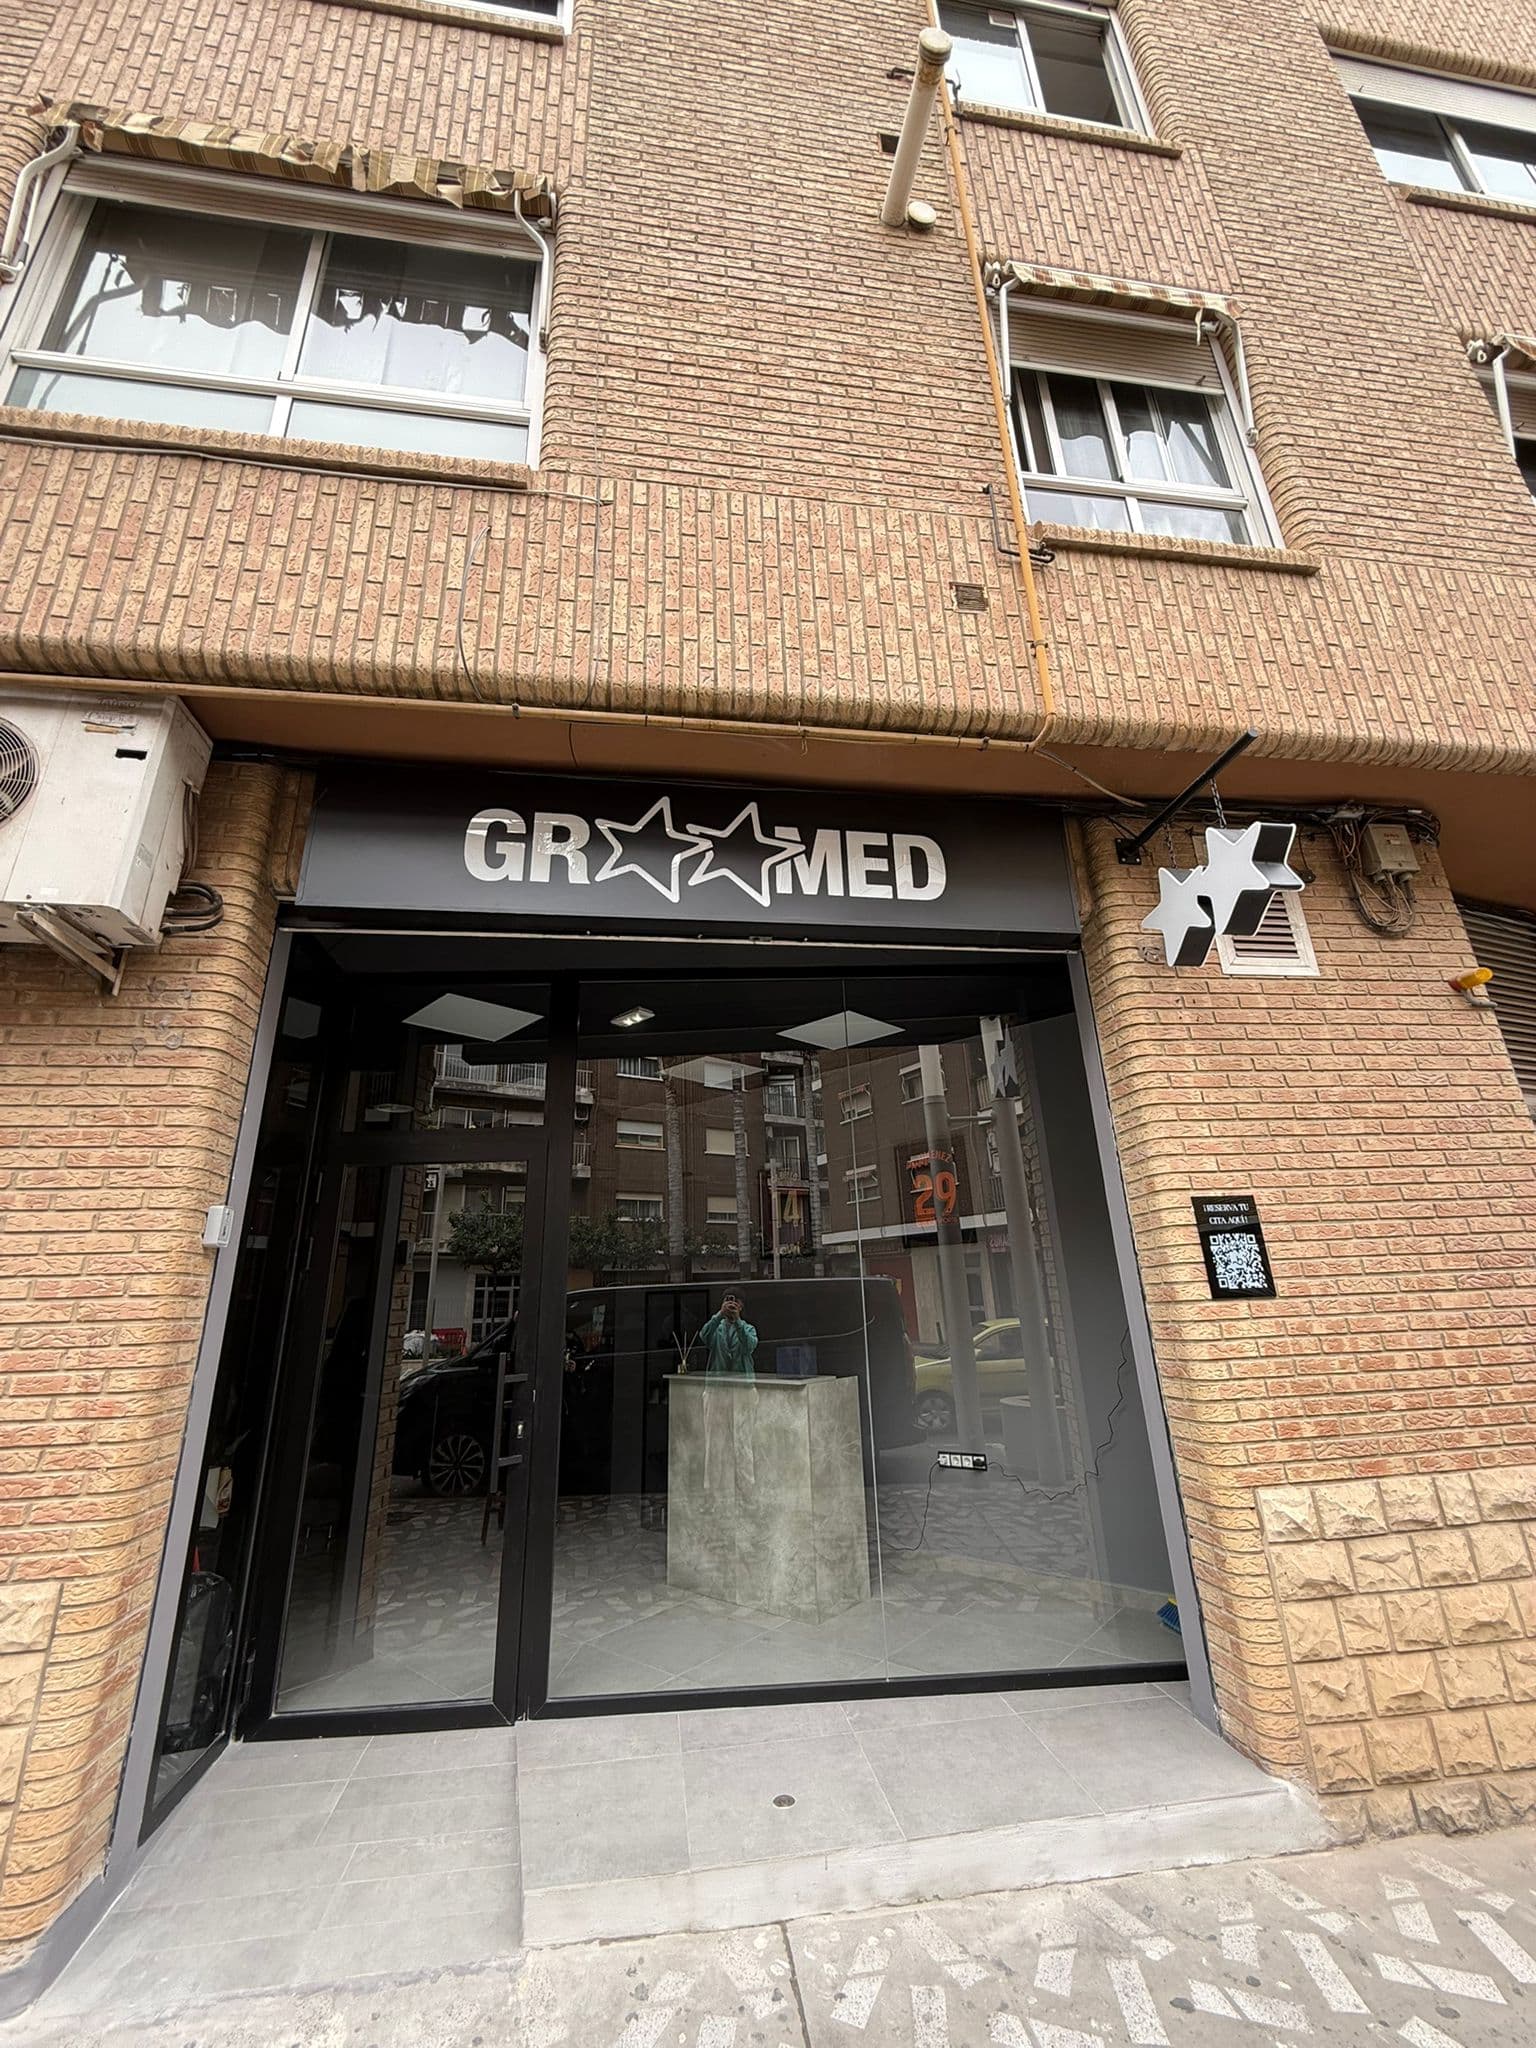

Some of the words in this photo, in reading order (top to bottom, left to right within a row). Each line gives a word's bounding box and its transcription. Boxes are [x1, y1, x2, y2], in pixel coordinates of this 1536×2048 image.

[914, 1170, 957, 1214] 29
[1238, 1203, 1249, 1211] TU
[1209, 1216, 1227, 1224] CITA
